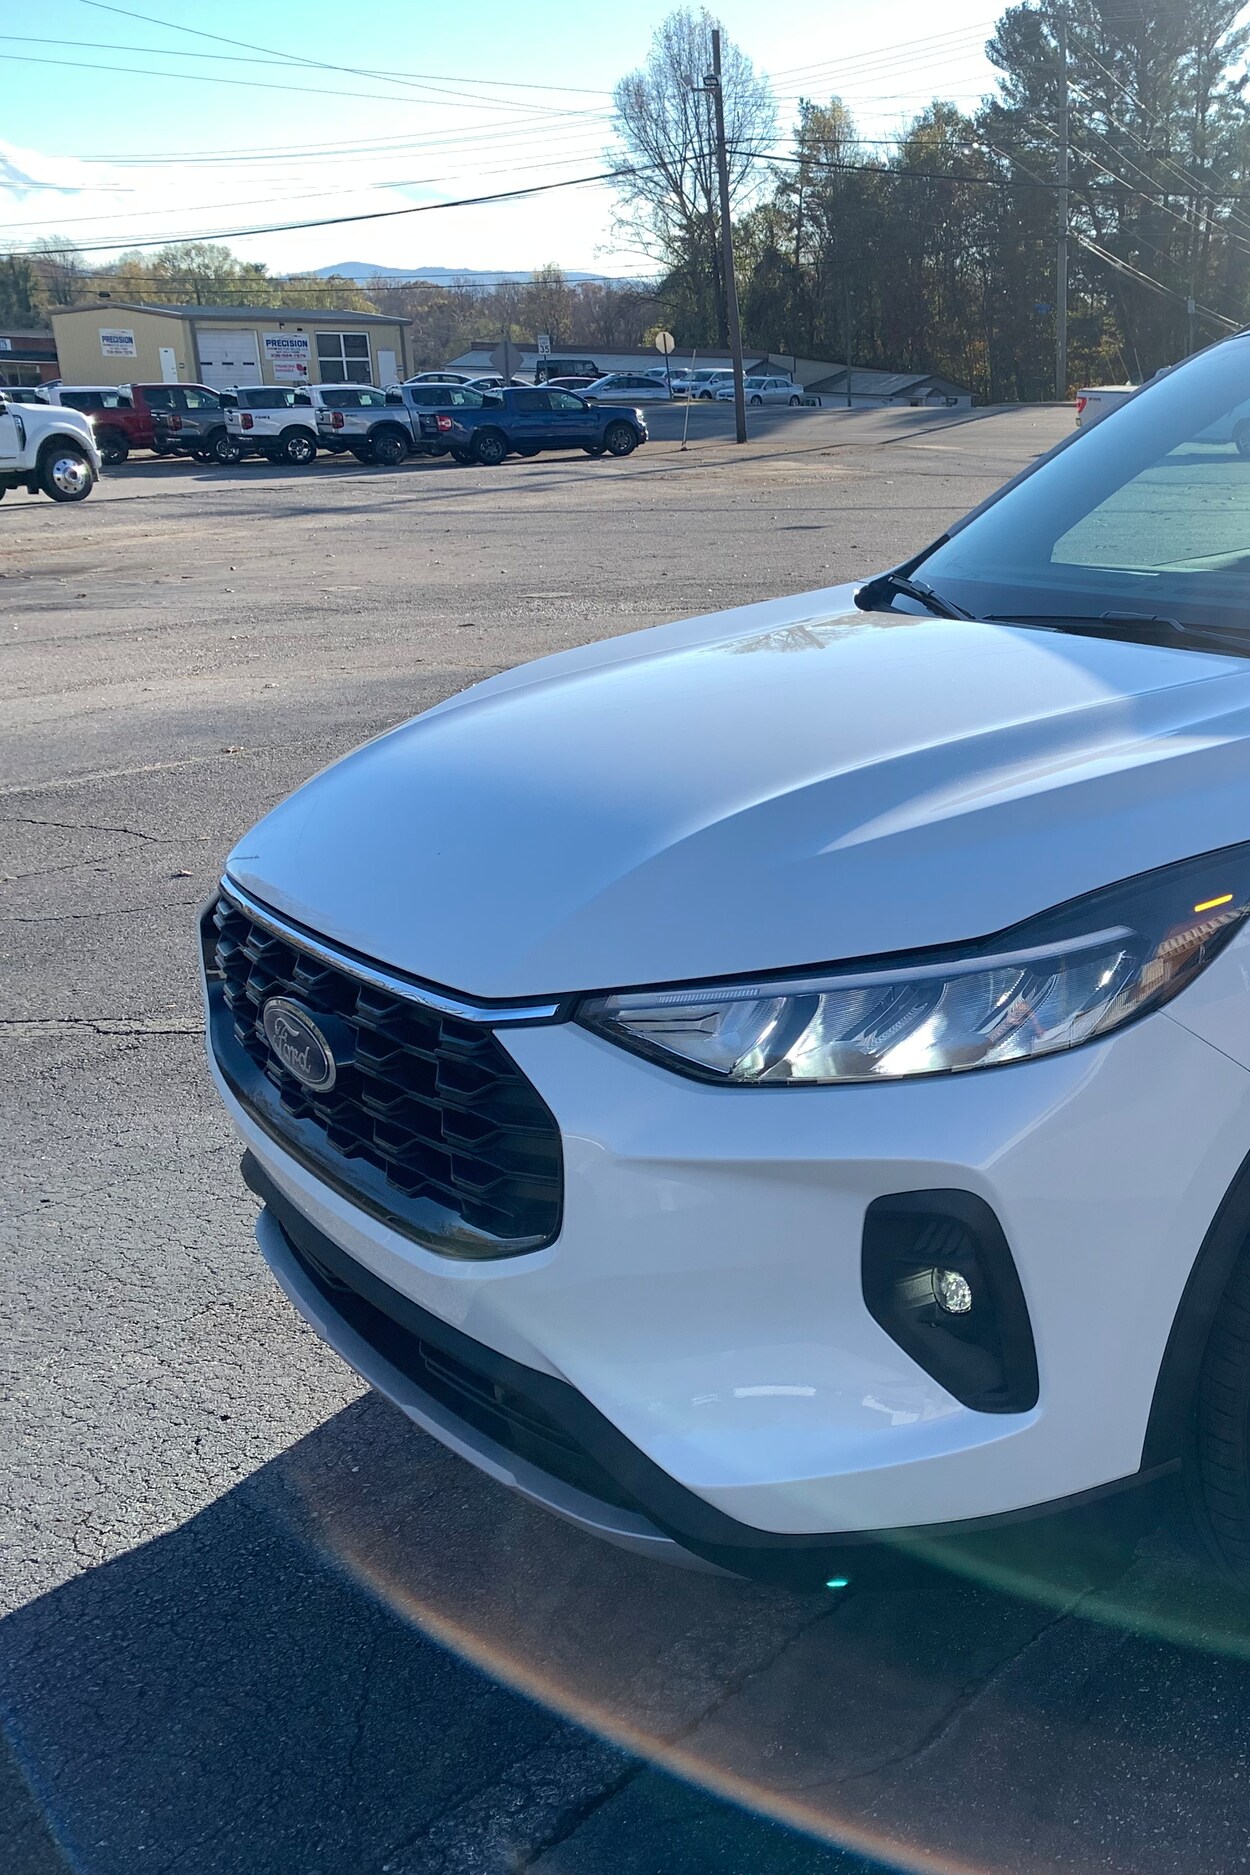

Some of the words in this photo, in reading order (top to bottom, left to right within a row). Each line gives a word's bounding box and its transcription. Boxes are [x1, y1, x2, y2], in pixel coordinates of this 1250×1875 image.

[101, 335, 134, 345] PRECISION
[265, 339, 309, 348] PRECISION
[539, 345, 550, 354] 35
[272, 1016, 312, 1074] Ford
